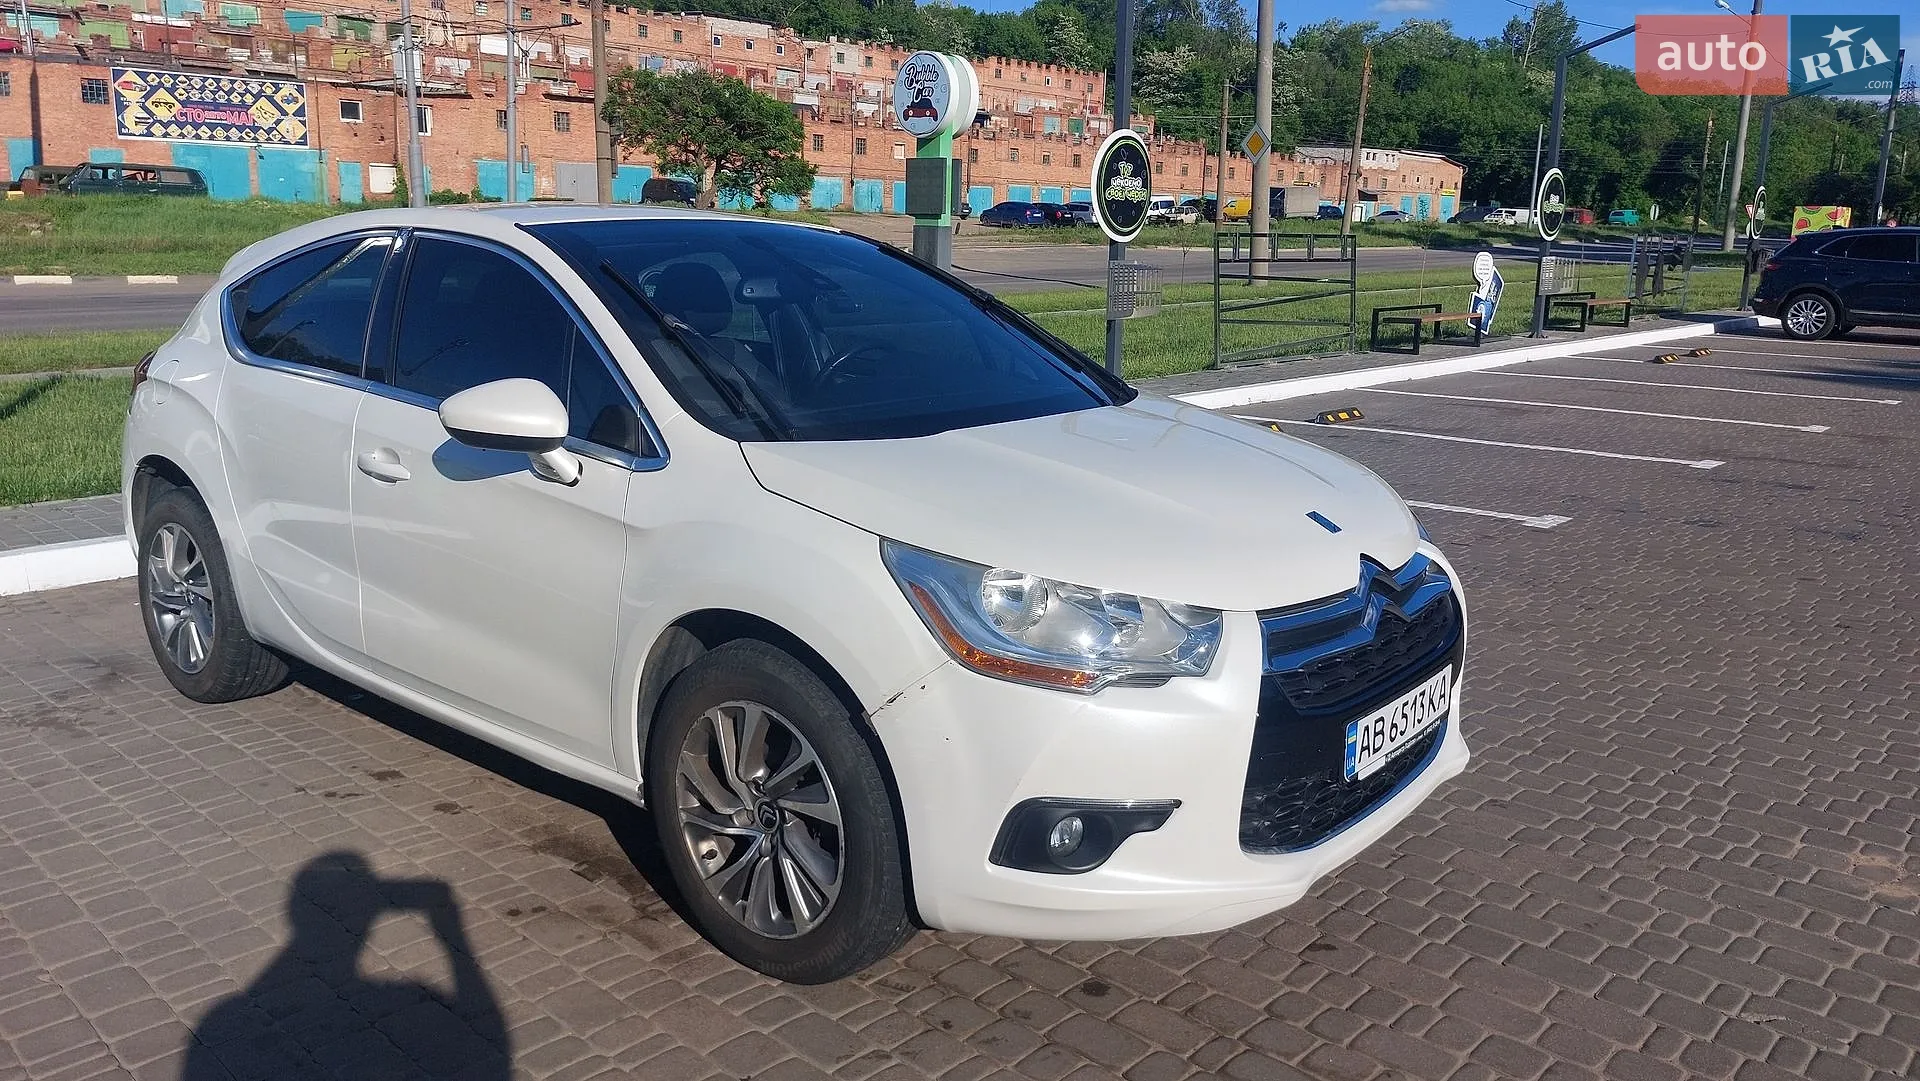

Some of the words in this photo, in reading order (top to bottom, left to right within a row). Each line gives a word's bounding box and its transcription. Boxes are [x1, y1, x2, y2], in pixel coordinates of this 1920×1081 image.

[904, 63, 939, 90] Bubble
[913, 81, 934, 102] Car
[1358, 716, 1385, 763] AB
[1389, 690, 1426, 743] 6513
[1427, 674, 1446, 718] KA
